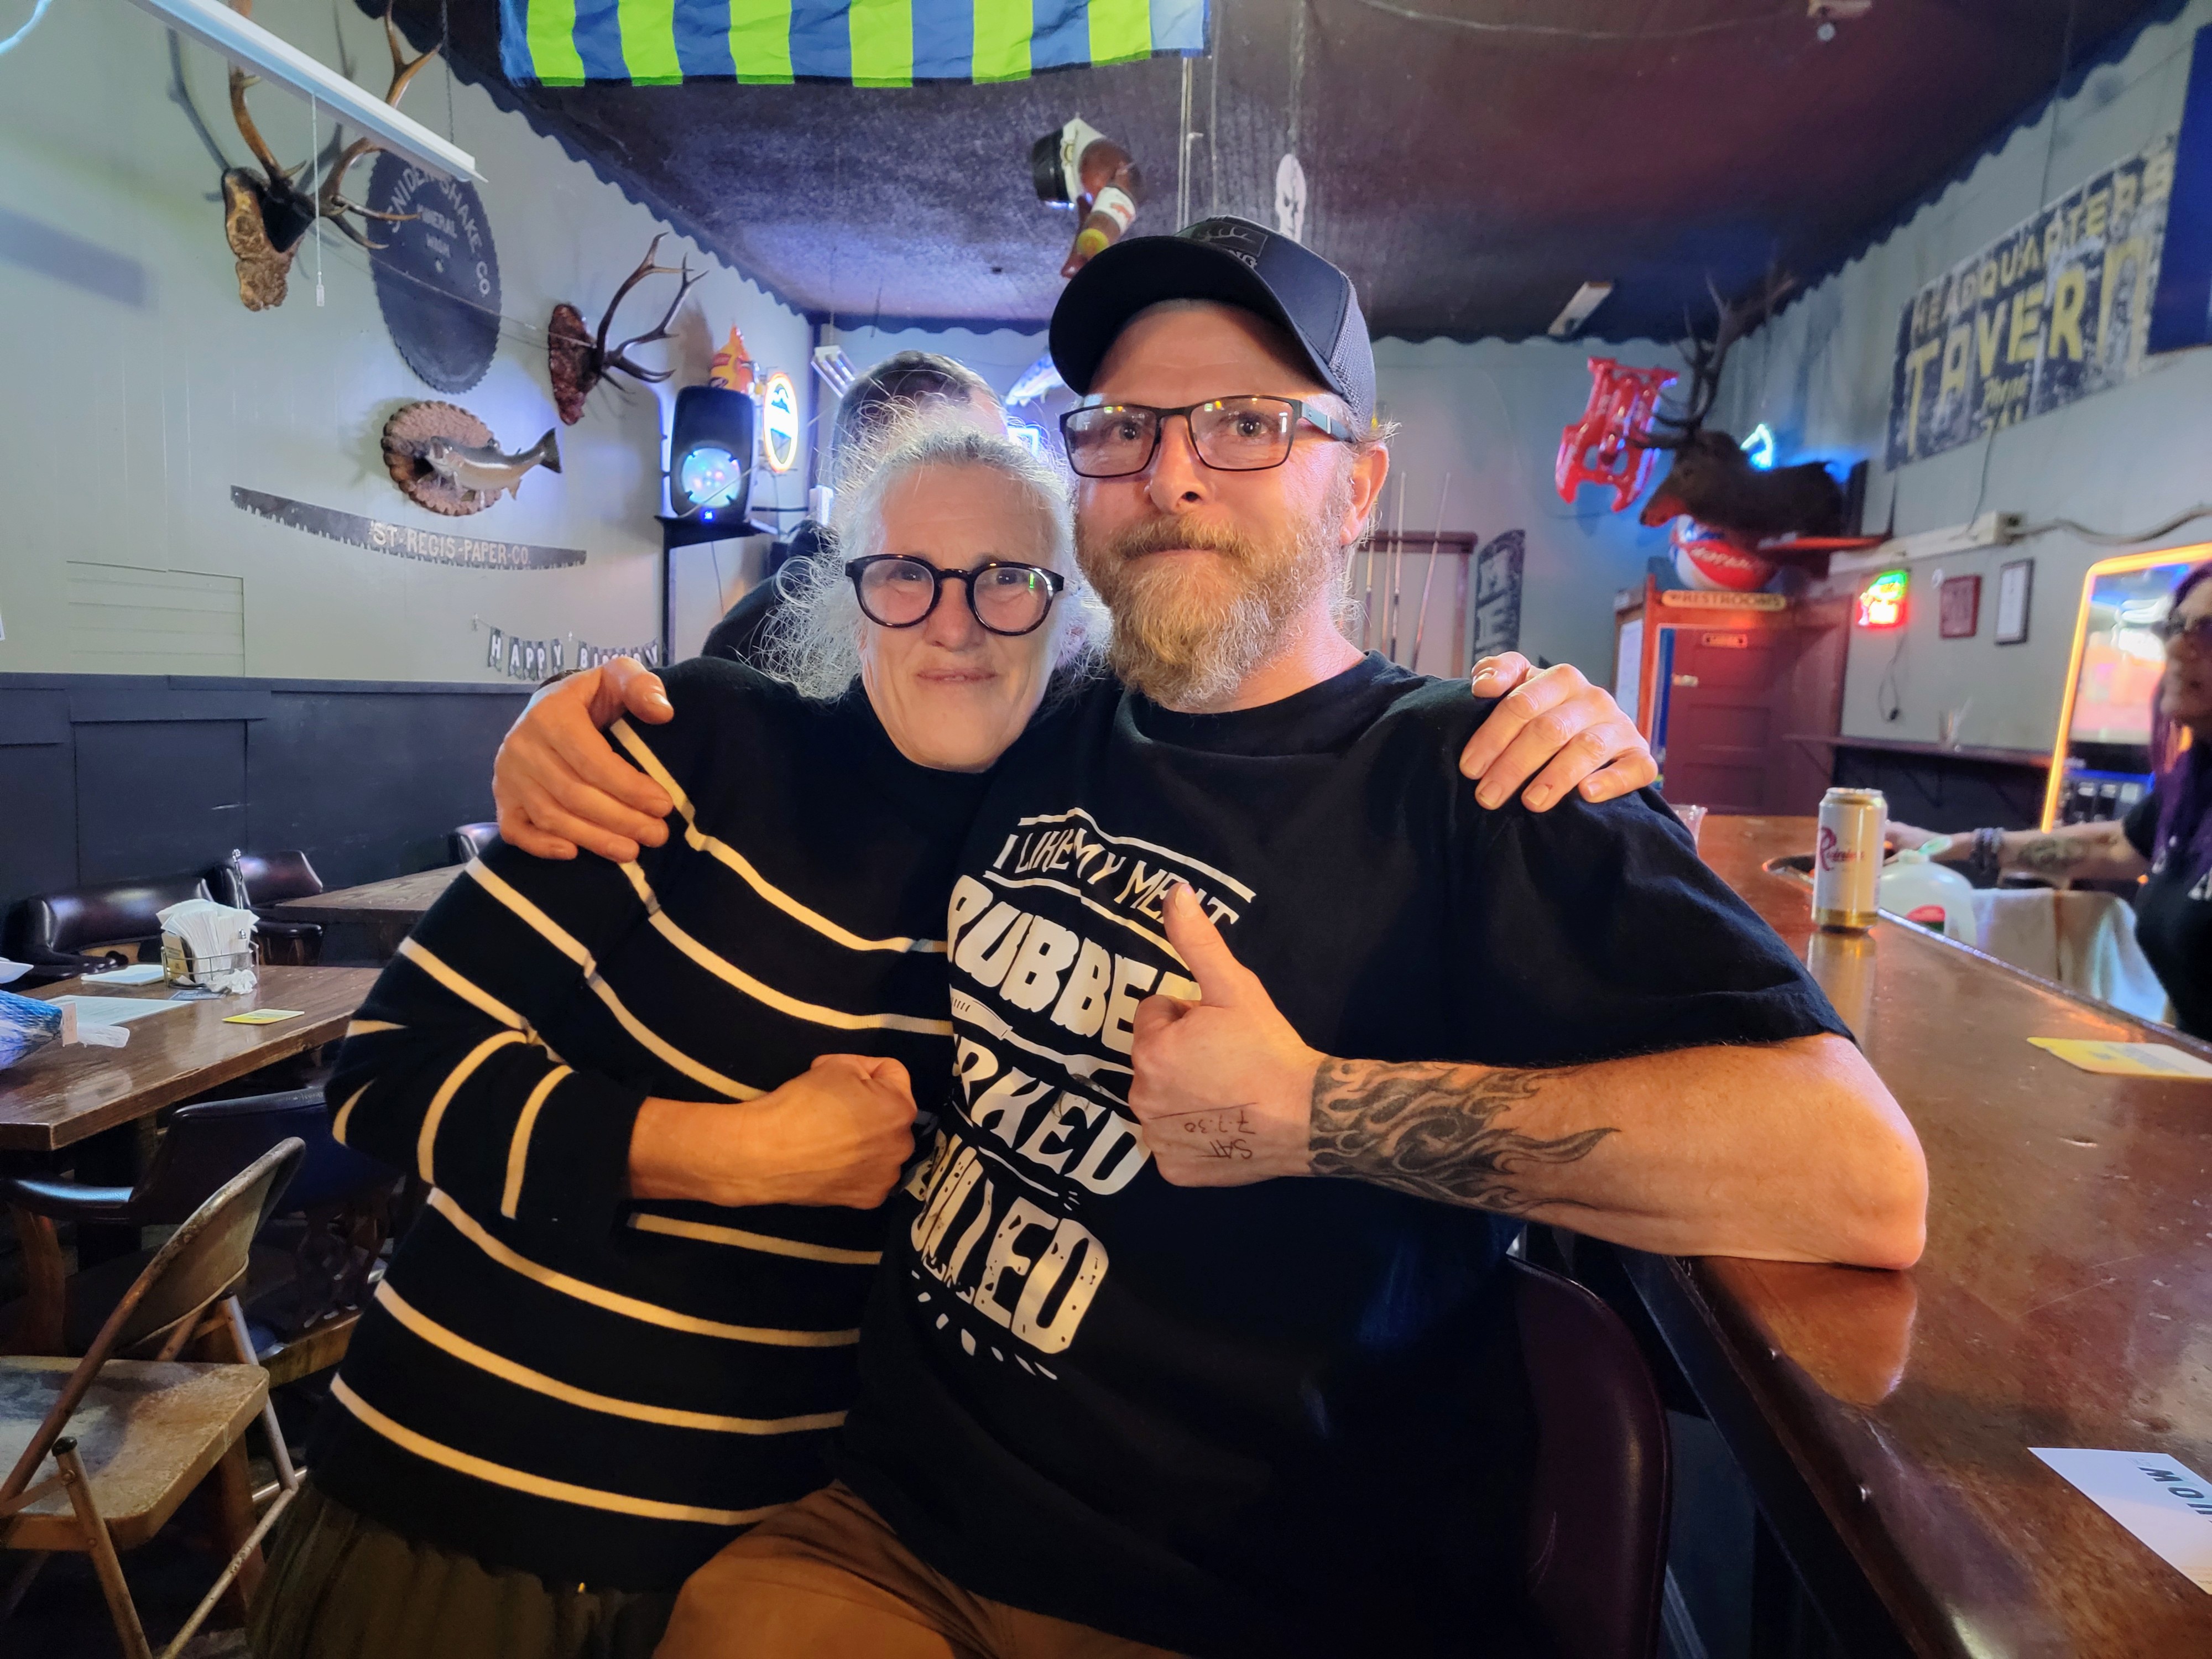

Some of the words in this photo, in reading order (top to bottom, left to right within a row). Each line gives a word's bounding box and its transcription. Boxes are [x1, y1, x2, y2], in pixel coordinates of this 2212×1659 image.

[491, 635, 562, 669] HAPPY
[993, 834, 1019, 869] I
[1014, 829, 1075, 873] LIKE
[1074, 828, 1126, 885] MY
[1114, 860, 1240, 925] MET
